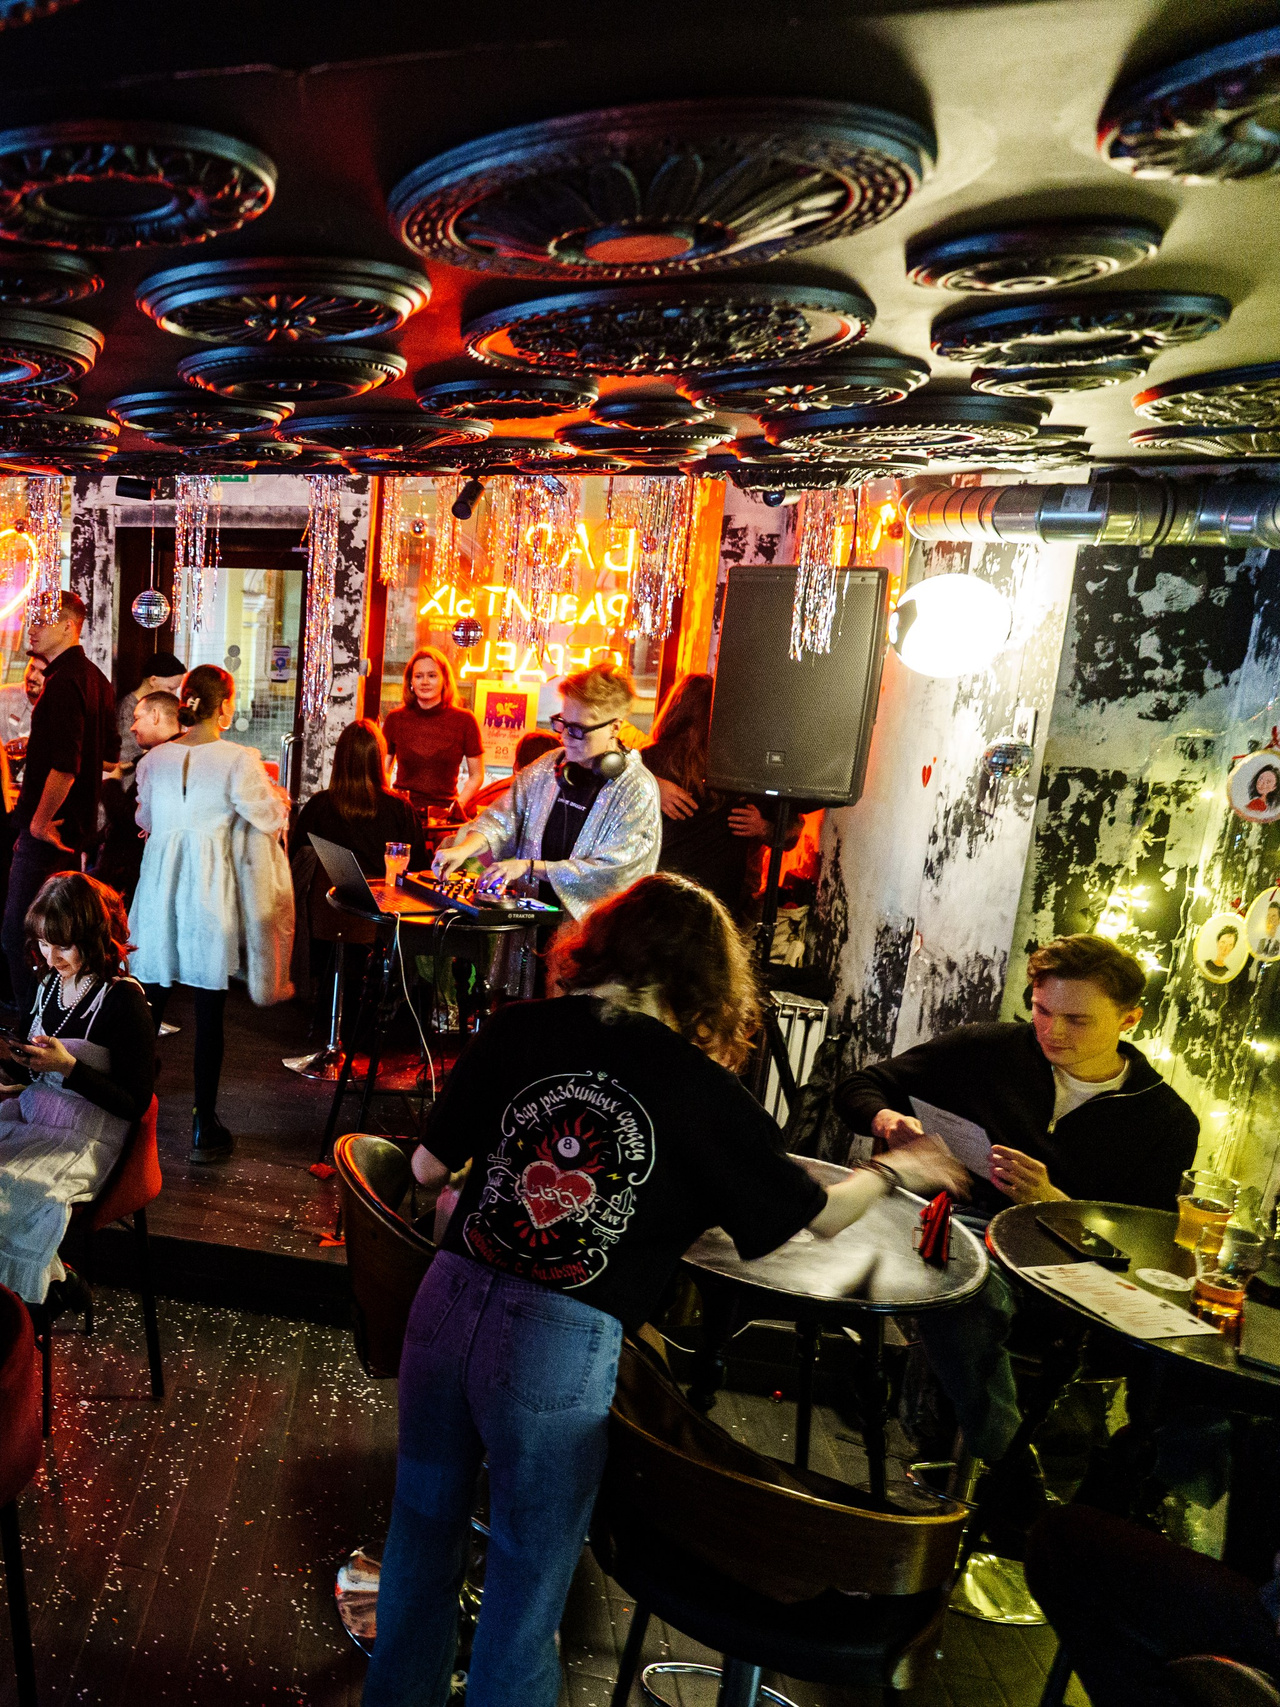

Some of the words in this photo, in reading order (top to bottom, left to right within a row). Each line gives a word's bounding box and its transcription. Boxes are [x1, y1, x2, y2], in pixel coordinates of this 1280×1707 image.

[494, 745, 509, 755] 26
[512, 1102, 541, 1126] бар
[539, 1076, 623, 1117] разбитых
[612, 1110, 647, 1161] сердец
[563, 1138, 573, 1150] 8
